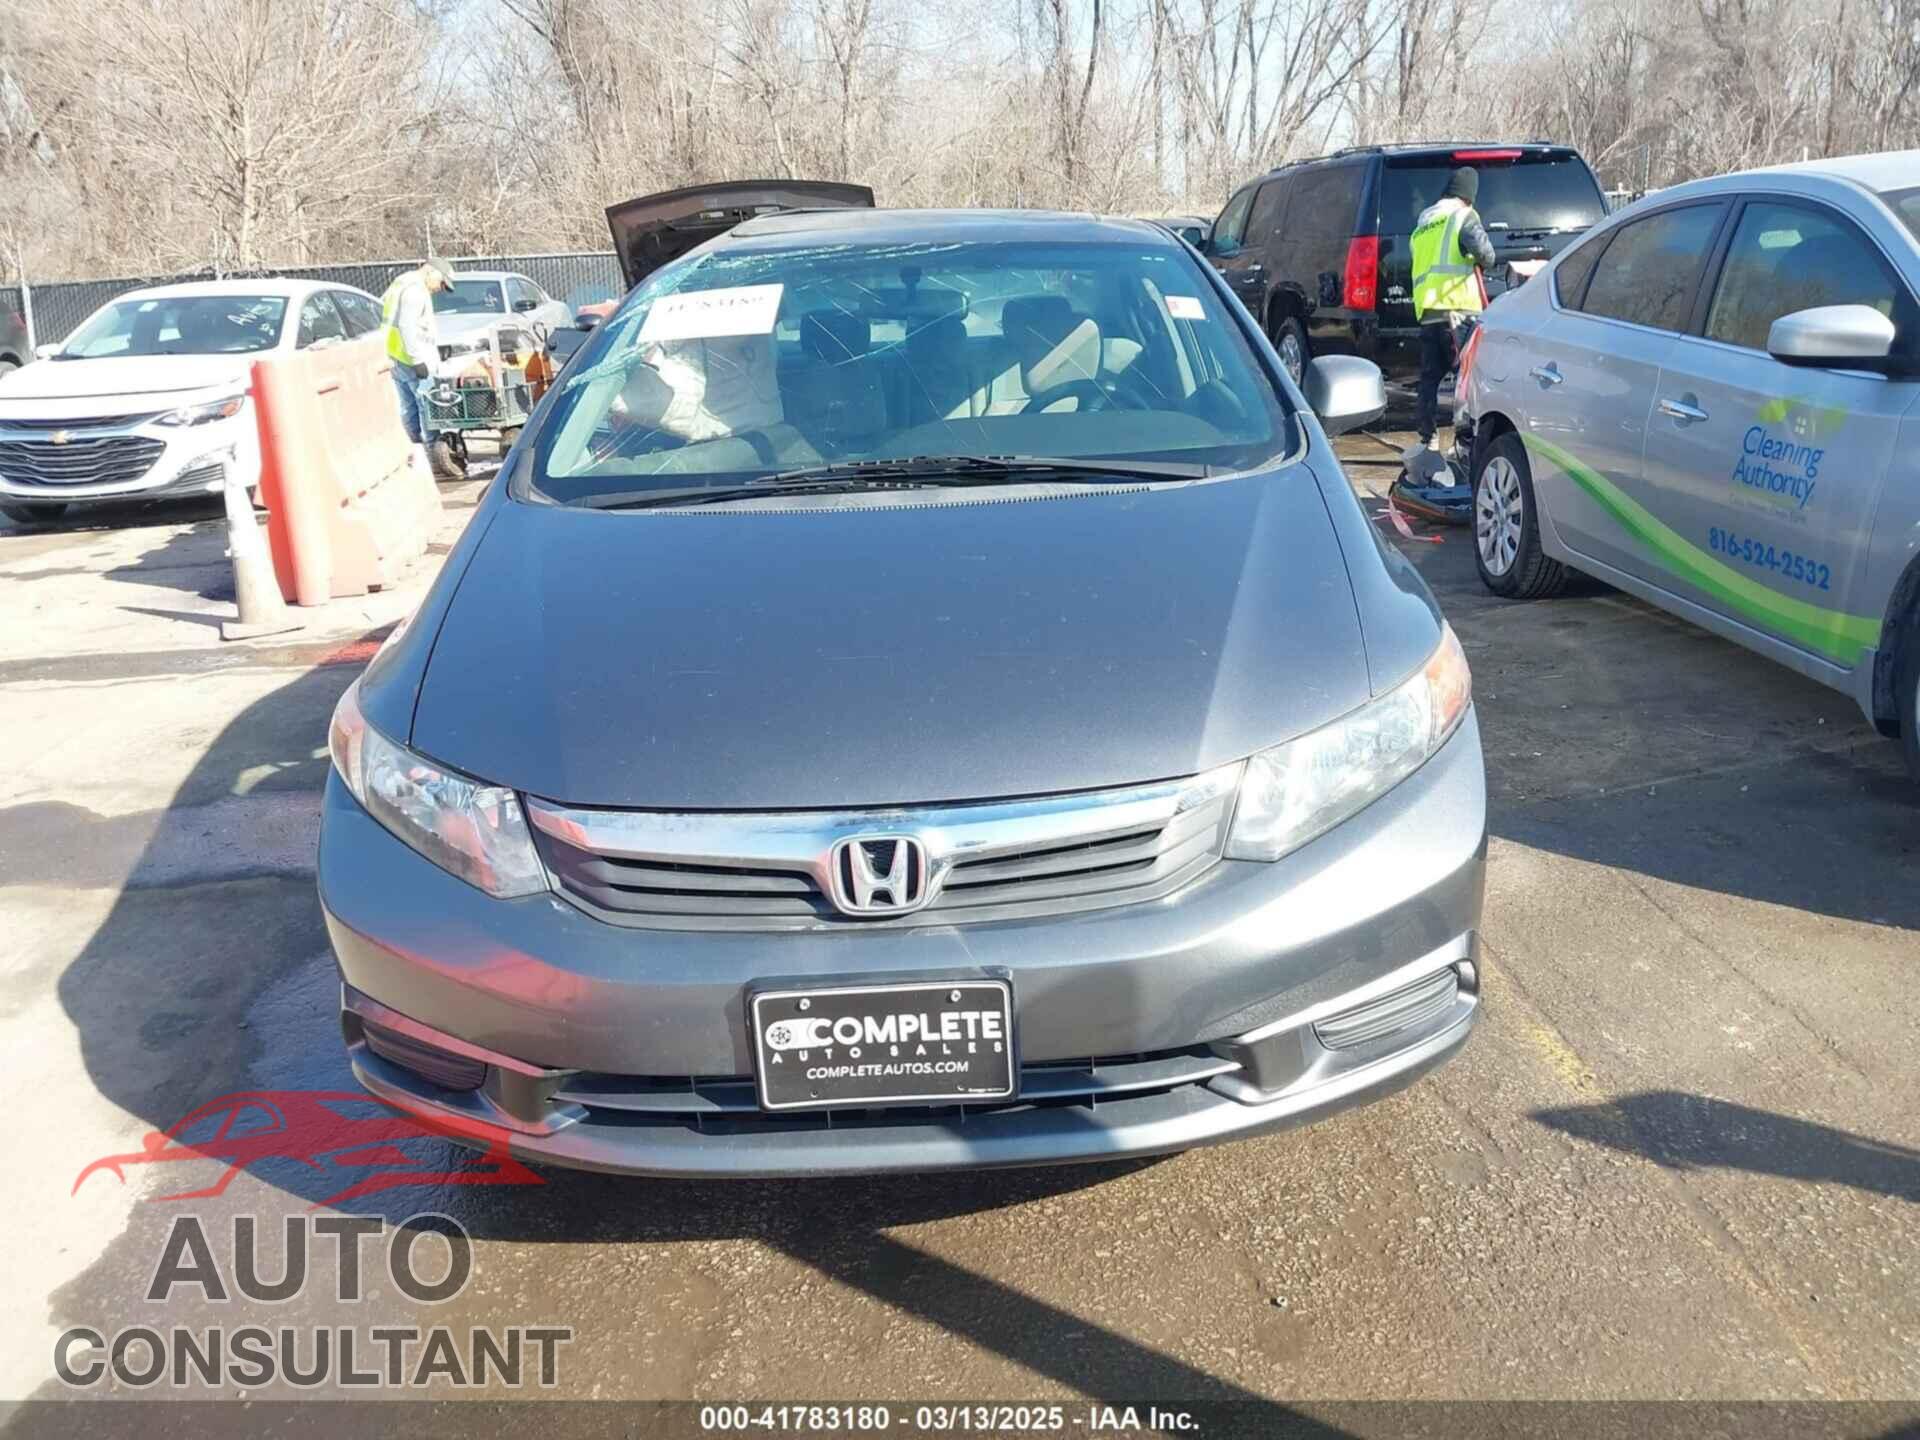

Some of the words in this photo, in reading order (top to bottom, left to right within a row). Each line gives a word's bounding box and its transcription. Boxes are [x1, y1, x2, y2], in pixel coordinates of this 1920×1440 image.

[1743, 426, 1824, 478] Cleaning
[1732, 455, 1815, 510] Authority
[1709, 527, 1830, 591] 816-524-2532
[807, 1011, 1003, 1047] COMPLETE
[772, 1046, 862, 1065] AUTO
[890, 1041, 1003, 1058] SALES
[806, 1060, 970, 1080] COMPLETEAUTOS.COM
